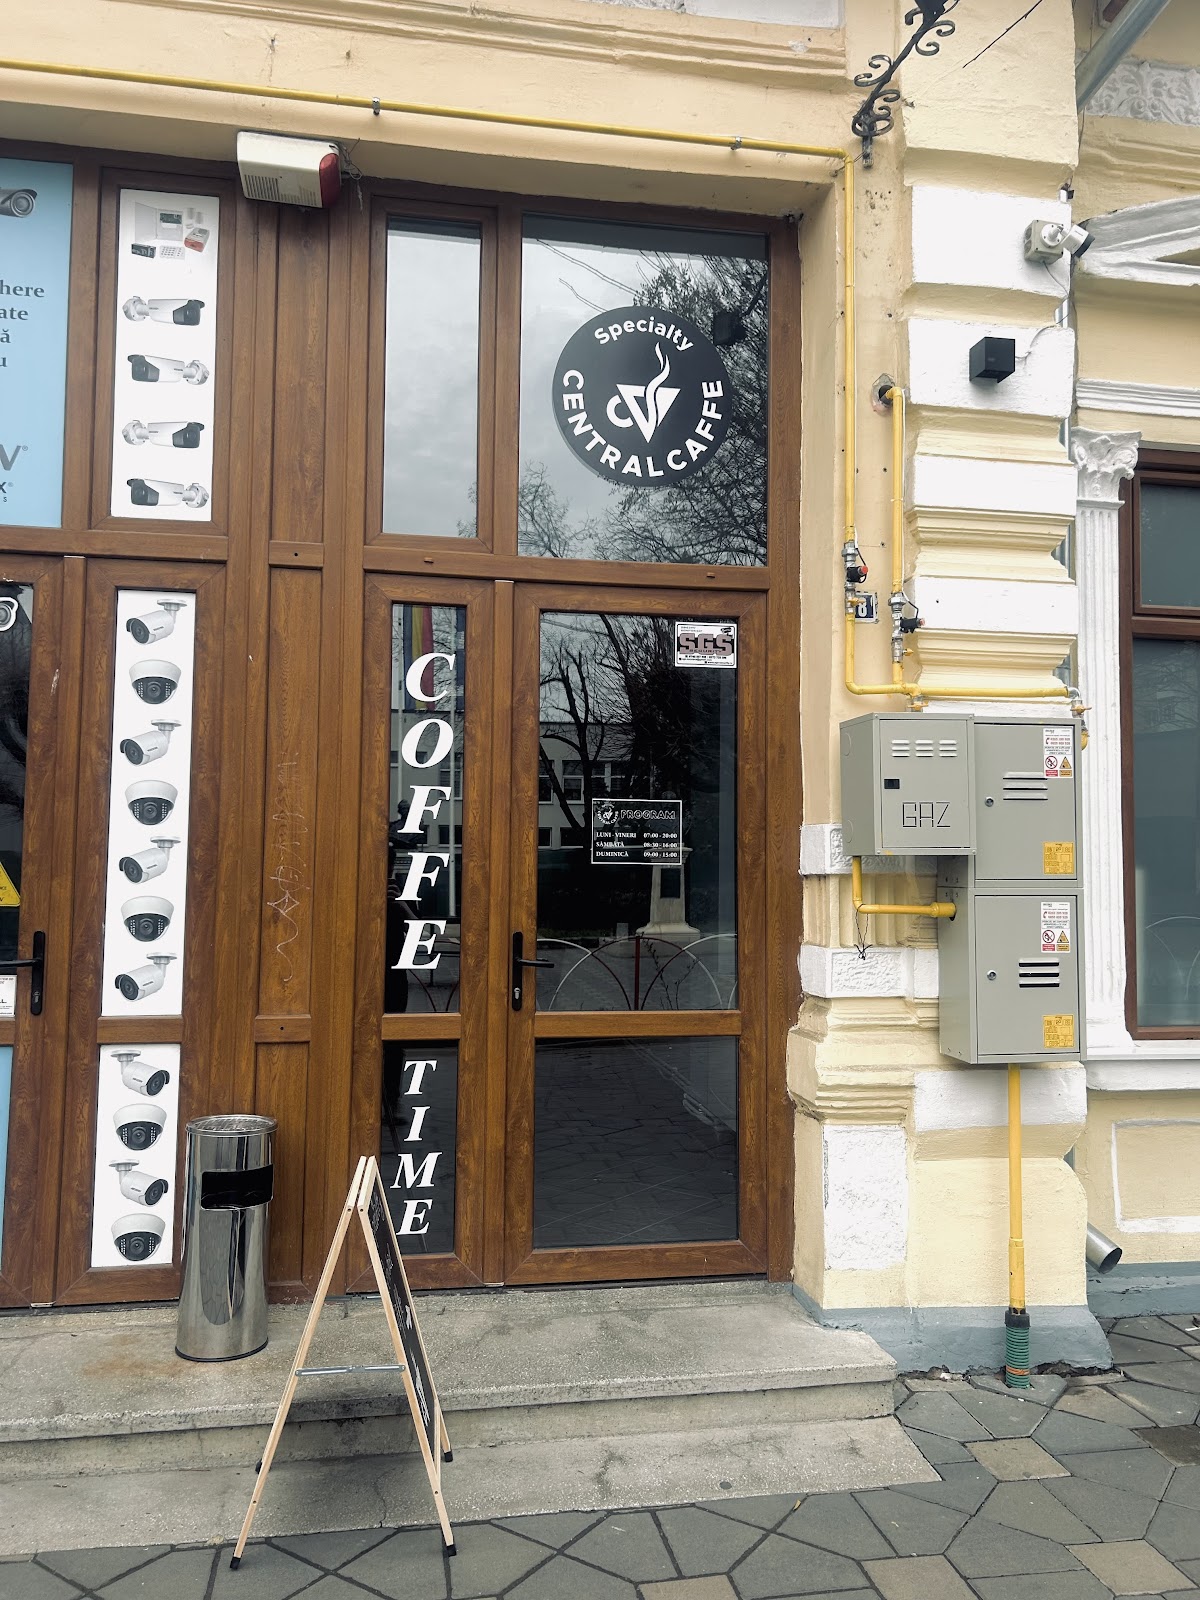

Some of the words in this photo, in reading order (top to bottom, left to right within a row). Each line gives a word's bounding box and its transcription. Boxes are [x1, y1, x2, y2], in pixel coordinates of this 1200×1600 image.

[594, 316, 694, 351] Specialty
[563, 369, 665, 477] CENTRAL
[666, 380, 724, 471] CAFFE
[679, 633, 732, 656] SGS
[391, 652, 456, 970] COFFE
[620, 809, 676, 820] PROGRAM
[902, 801, 951, 828] GAZ
[389, 1060, 443, 1236] TIME
